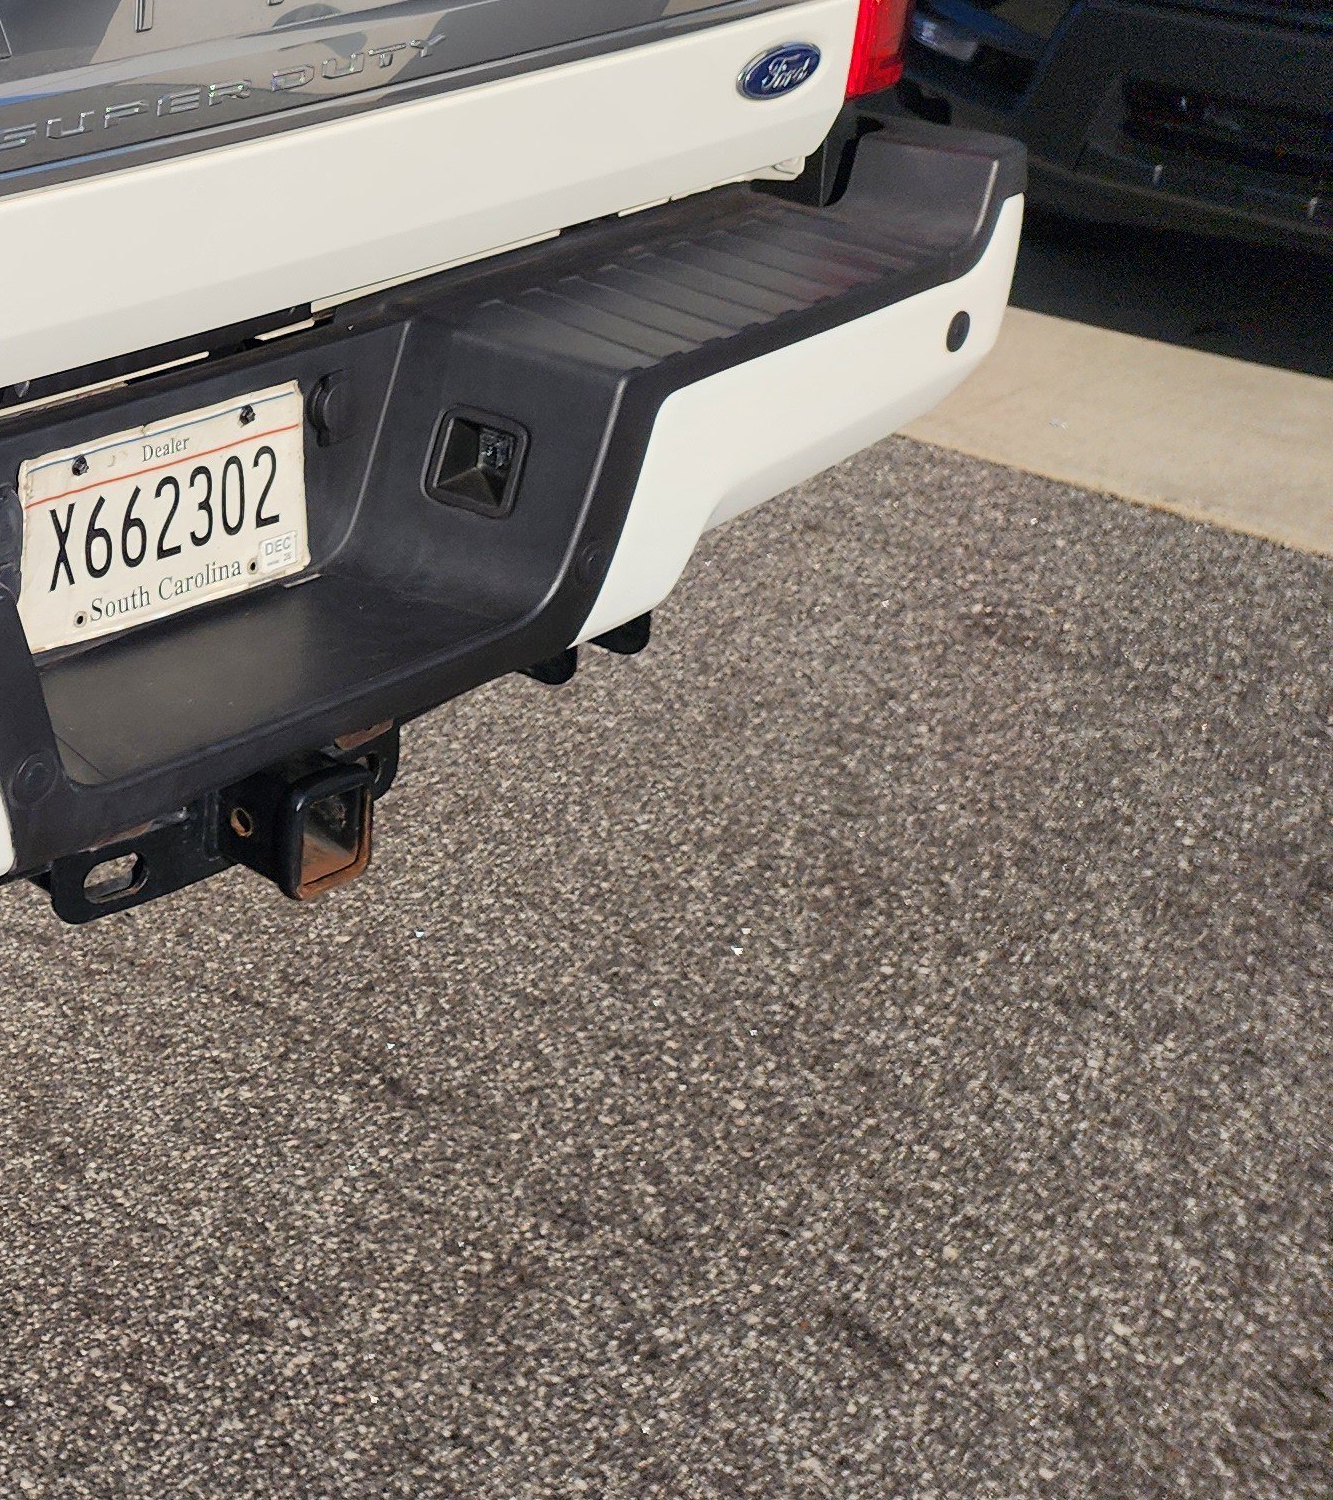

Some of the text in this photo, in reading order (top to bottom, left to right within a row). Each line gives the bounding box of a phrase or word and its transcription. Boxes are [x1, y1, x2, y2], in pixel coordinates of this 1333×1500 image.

[271, 33, 446, 92] DUTY
[758, 52, 812, 91] Ford
[142, 437, 190, 462] Dealer
[49, 445, 280, 593] X662302
[265, 537, 291, 555] DEC
[90, 560, 242, 622] South Carolina
